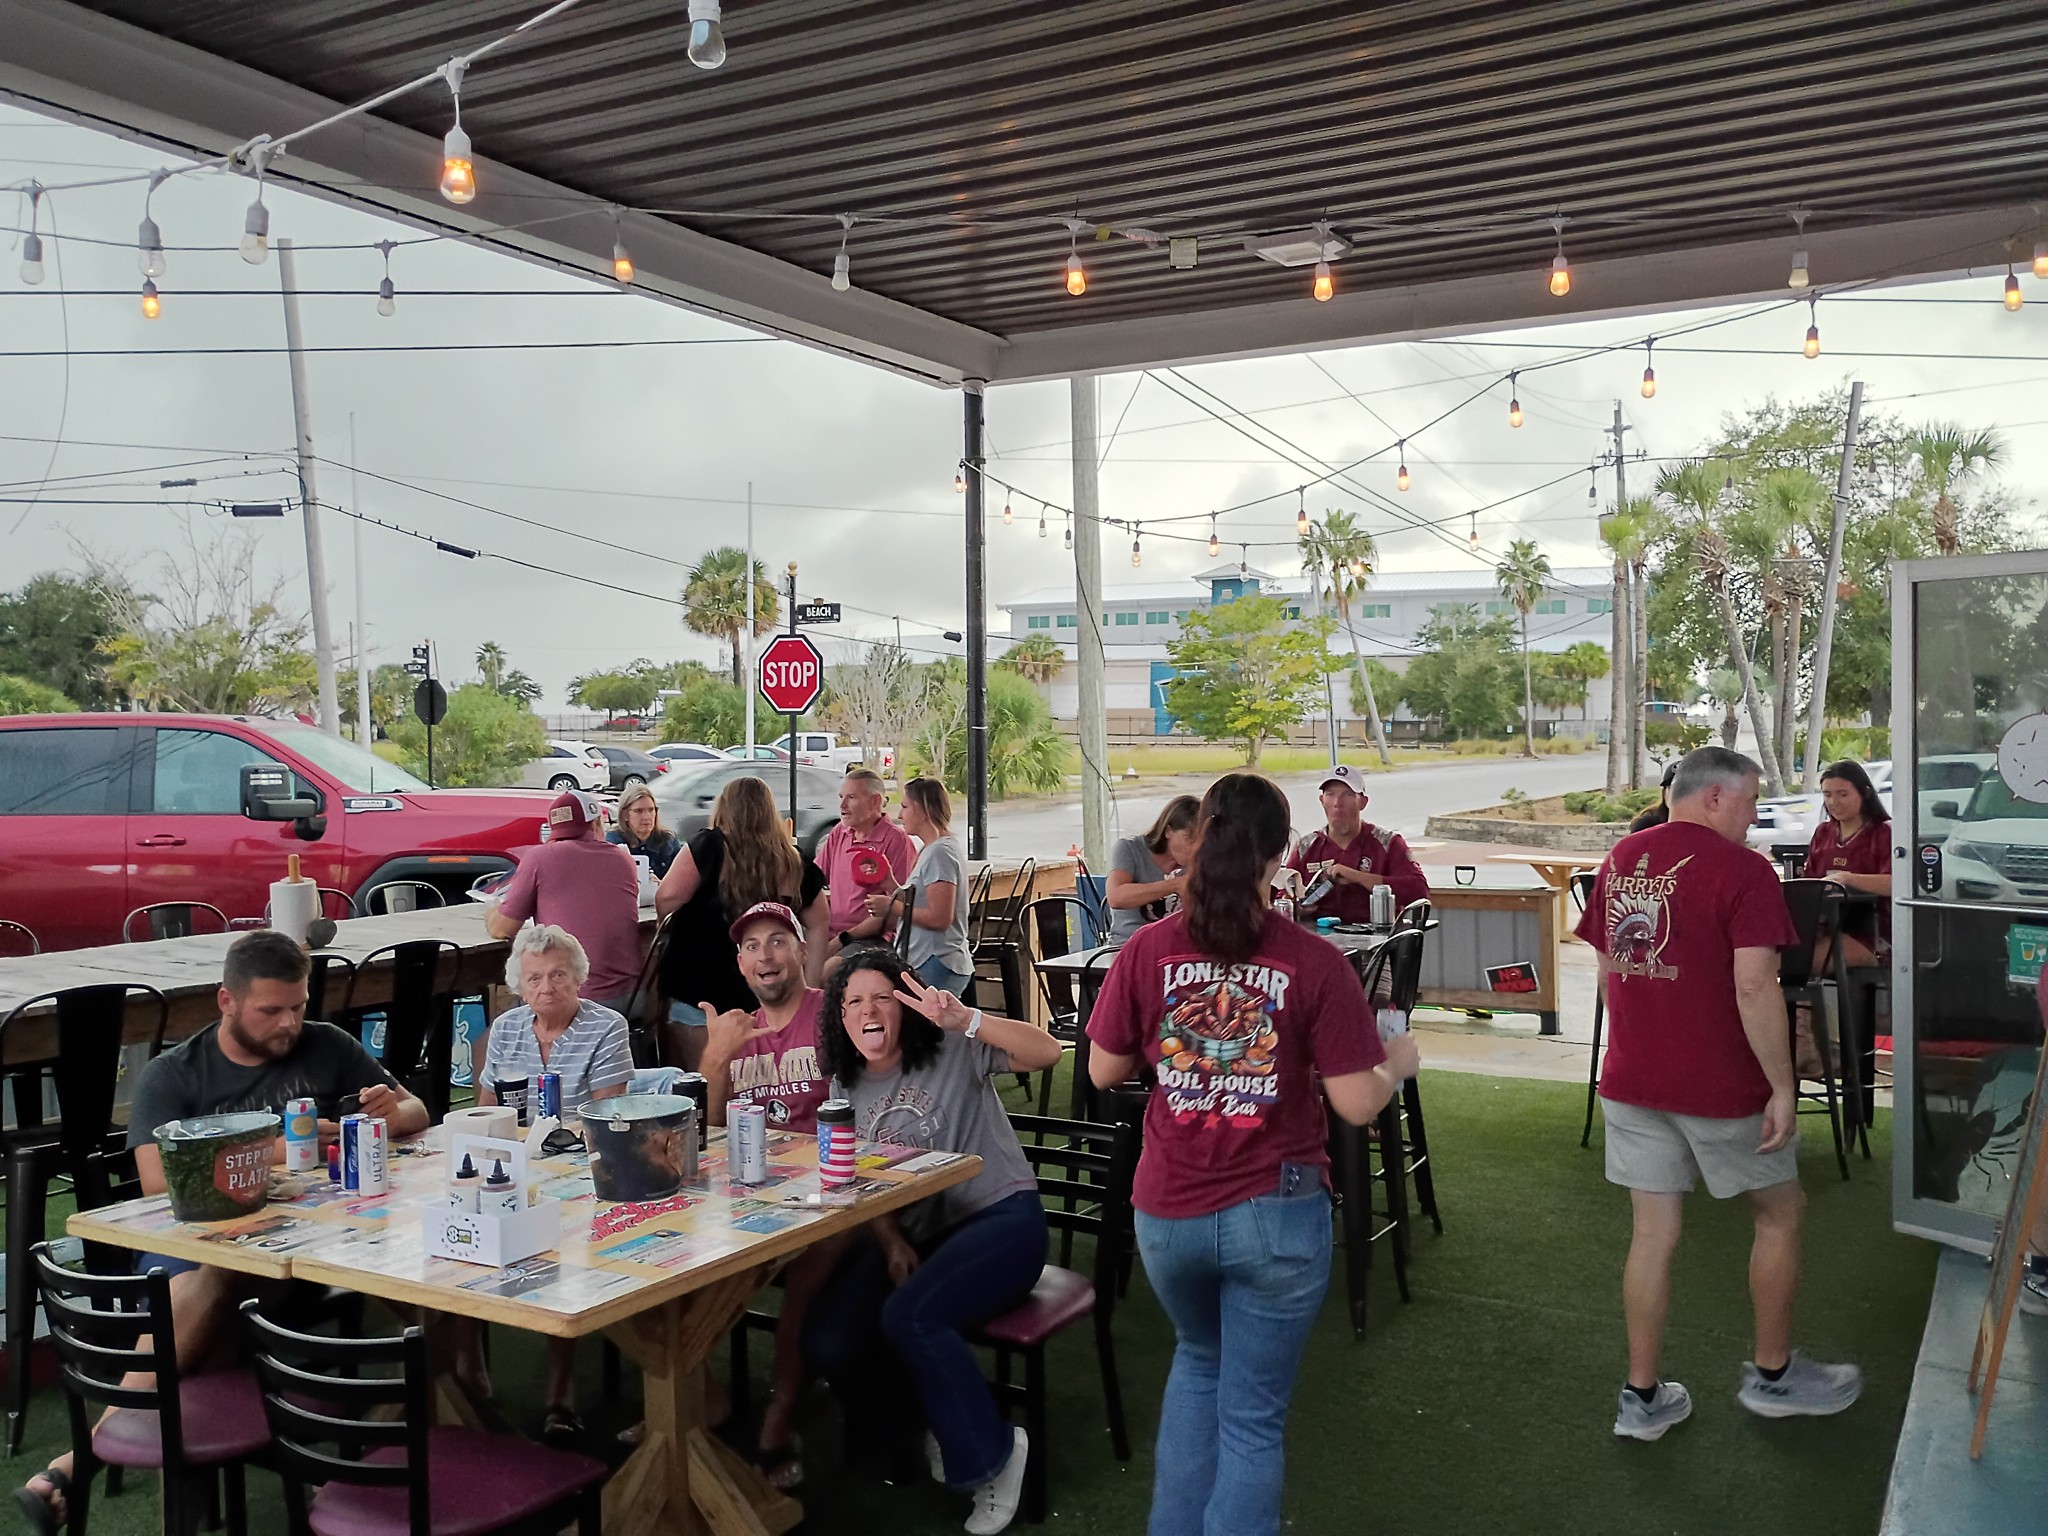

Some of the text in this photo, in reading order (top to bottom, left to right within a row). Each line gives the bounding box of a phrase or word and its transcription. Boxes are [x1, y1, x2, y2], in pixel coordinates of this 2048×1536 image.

[806, 606, 832, 617] BEACH
[765, 661, 815, 688] STOP
[1163, 962, 1290, 1011] LONE STAR
[1157, 1063, 1279, 1098] BOIL HOUSE
[1221, 1094, 1259, 1117] Bar
[920, 1117, 940, 1136] 51
[225, 1151, 260, 1169] STEP
[373, 1142, 383, 1182] ULTRA
